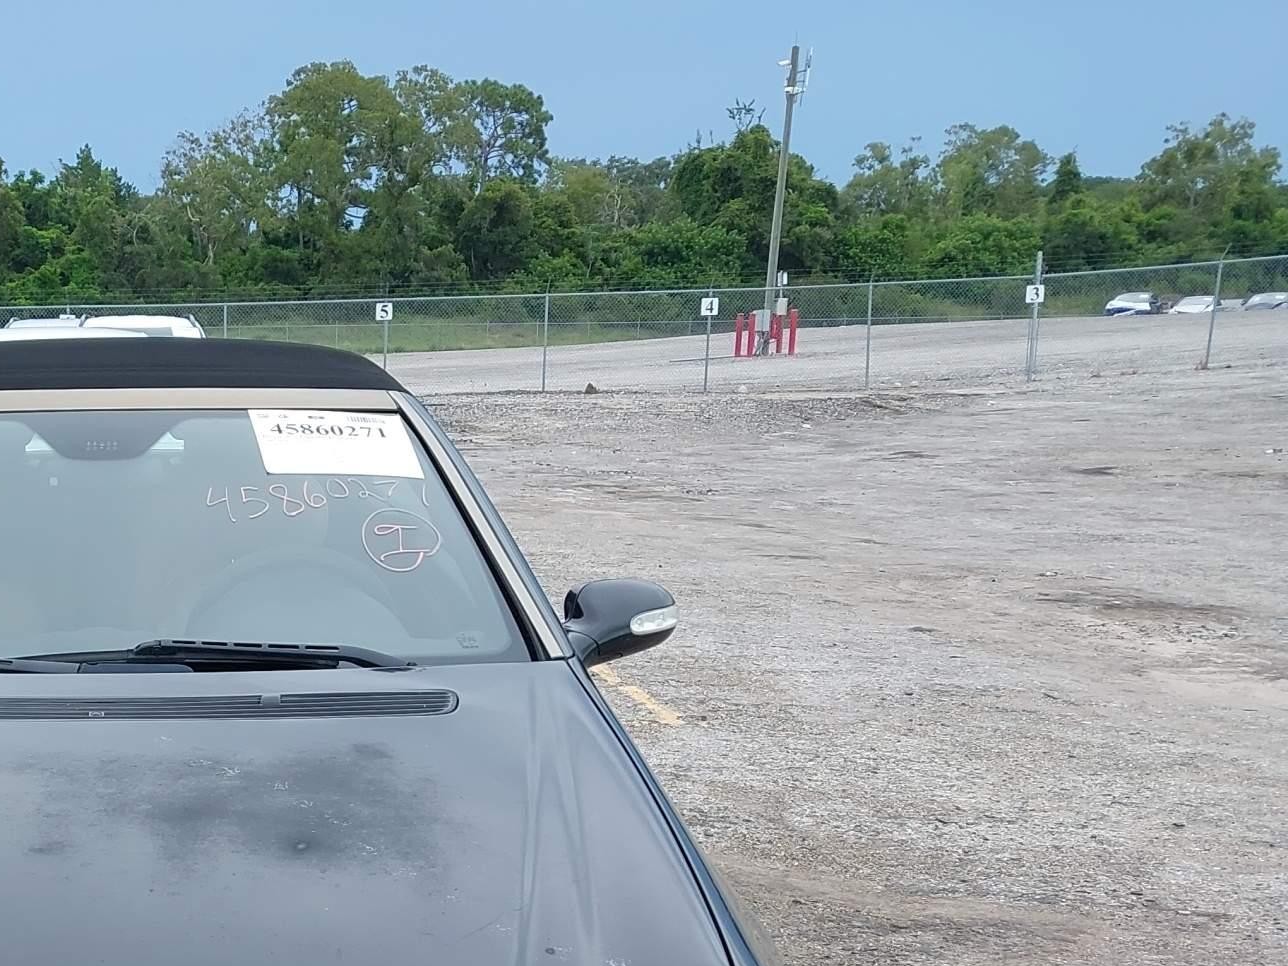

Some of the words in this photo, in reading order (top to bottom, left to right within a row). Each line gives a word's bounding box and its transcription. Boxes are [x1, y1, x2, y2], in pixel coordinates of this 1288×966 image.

[1031, 286, 1040, 302] 3
[379, 304, 390, 319] 5
[704, 299, 715, 314] 4
[270, 422, 387, 438] 45860271
[206, 477, 430, 523] 45860271
